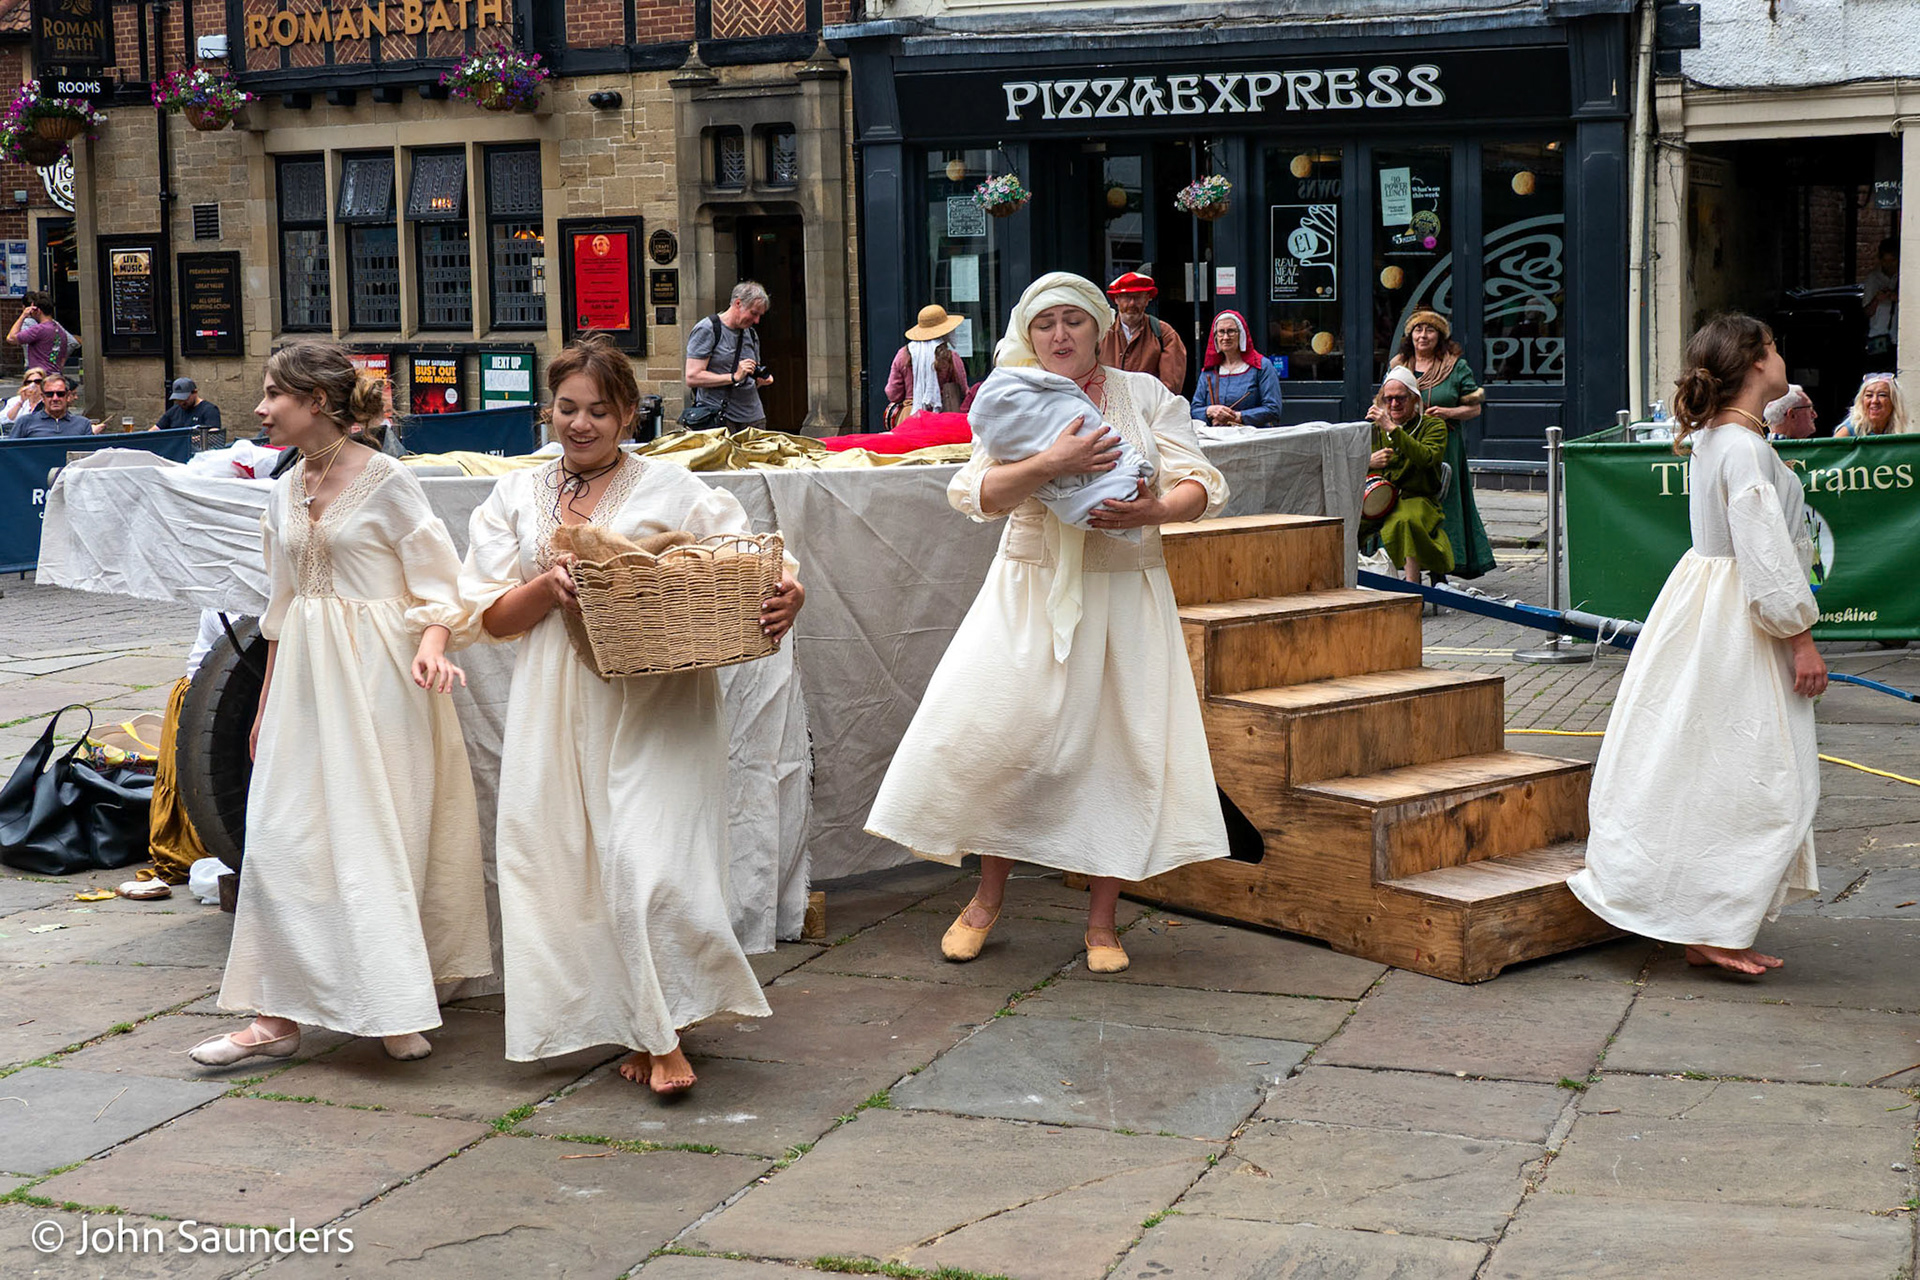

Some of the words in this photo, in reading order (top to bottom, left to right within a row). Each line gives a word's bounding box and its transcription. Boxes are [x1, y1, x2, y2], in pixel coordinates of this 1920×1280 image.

[42, 17, 104, 38] ROMAN
[249, 2, 388, 49] ROMAN
[404, 0, 502, 35] BATH
[57, 37, 93, 51] BATH
[58, 81, 101, 93] ROOMS
[1002, 65, 1446, 121] PIZZAEXPRESS
[1384, 182, 1408, 190] POWER
[1385, 189, 1407, 197] LUNCH
[123, 255, 138, 263] LIVE
[1274, 258, 1298, 268] REAL
[119, 264, 143, 273] MUSIC
[1274, 267, 1299, 276] MEAL
[1274, 276, 1298, 285] DEAL
[1484, 337, 1564, 374] PIZ
[491, 356, 510, 369] NEXT
[510, 356, 522, 369] UP
[414, 366, 436, 376] BUST
[437, 366, 456, 376] OUT
[434, 376, 457, 384] MOVES
